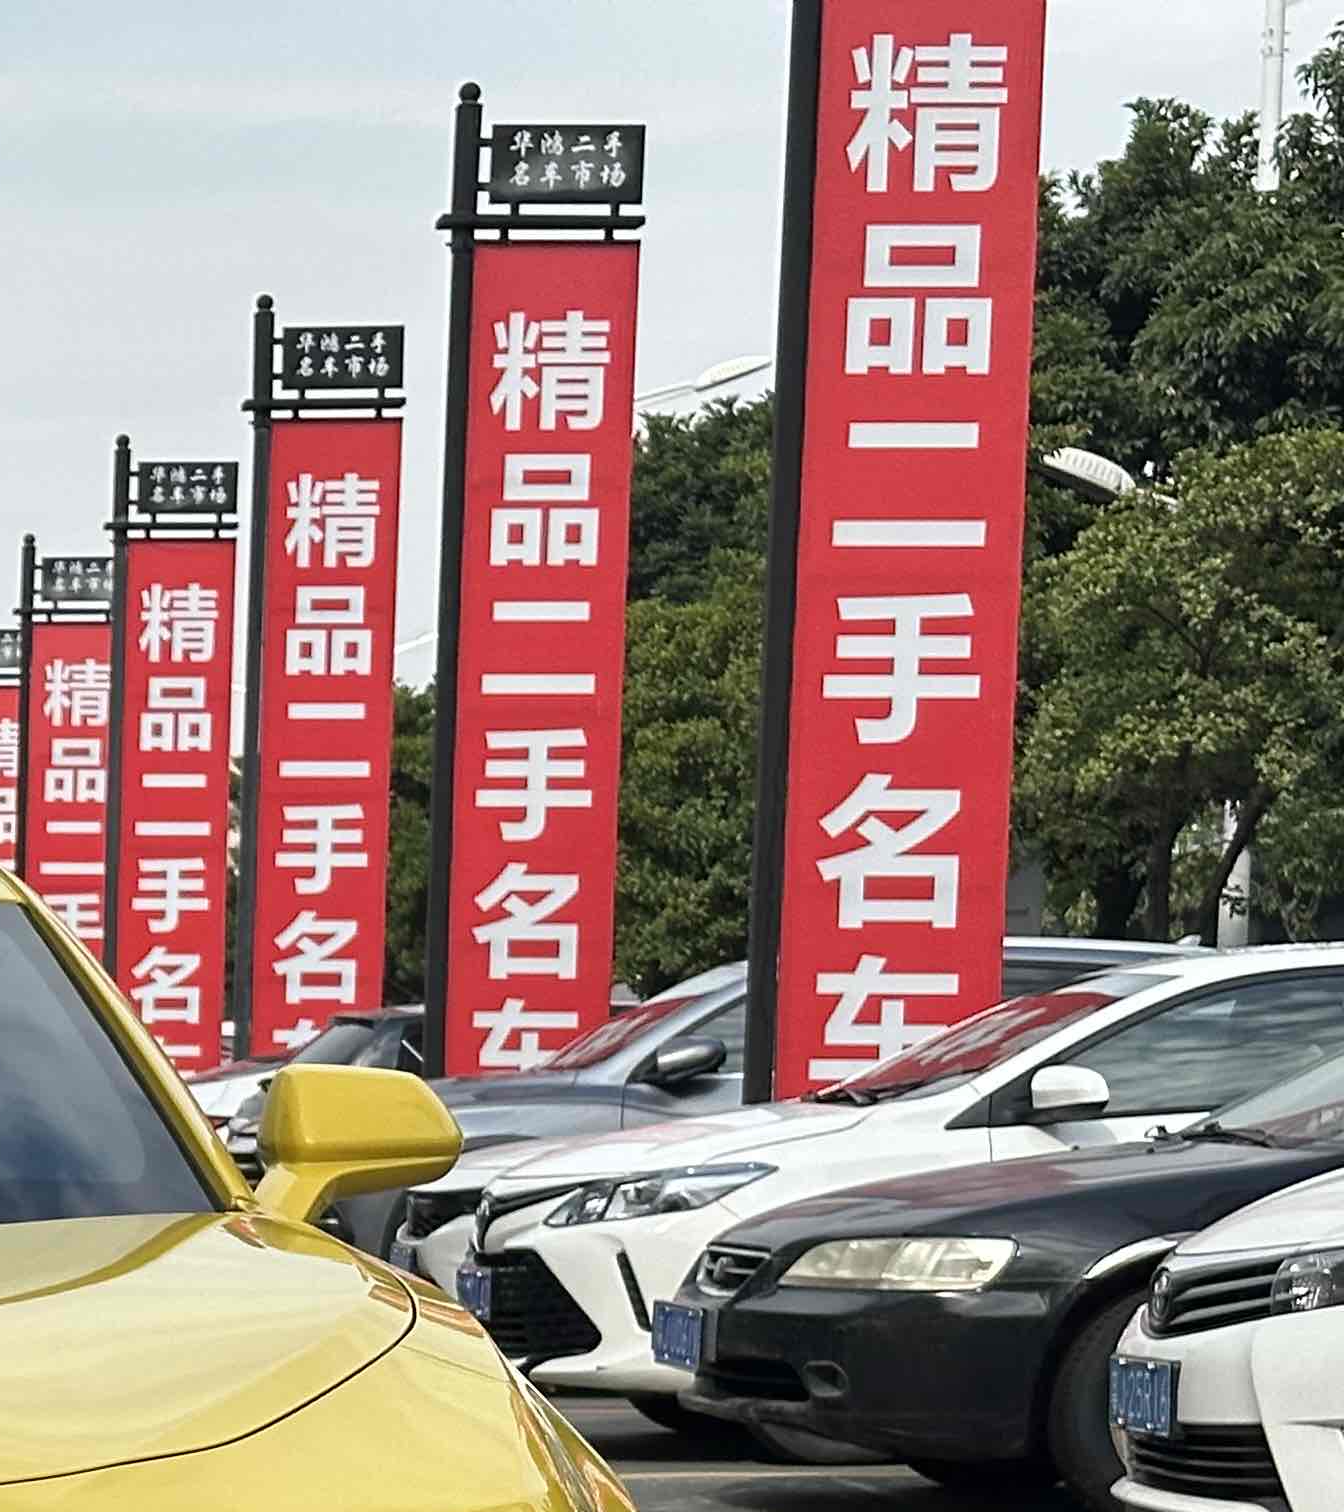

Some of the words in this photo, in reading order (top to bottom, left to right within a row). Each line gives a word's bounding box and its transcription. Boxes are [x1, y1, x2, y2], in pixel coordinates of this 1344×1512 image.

[509, 129, 624, 158] 华鸿二手
[509, 160, 626, 190] 名车市场
[809, 33, 1008, 1083] 精品二手名车
